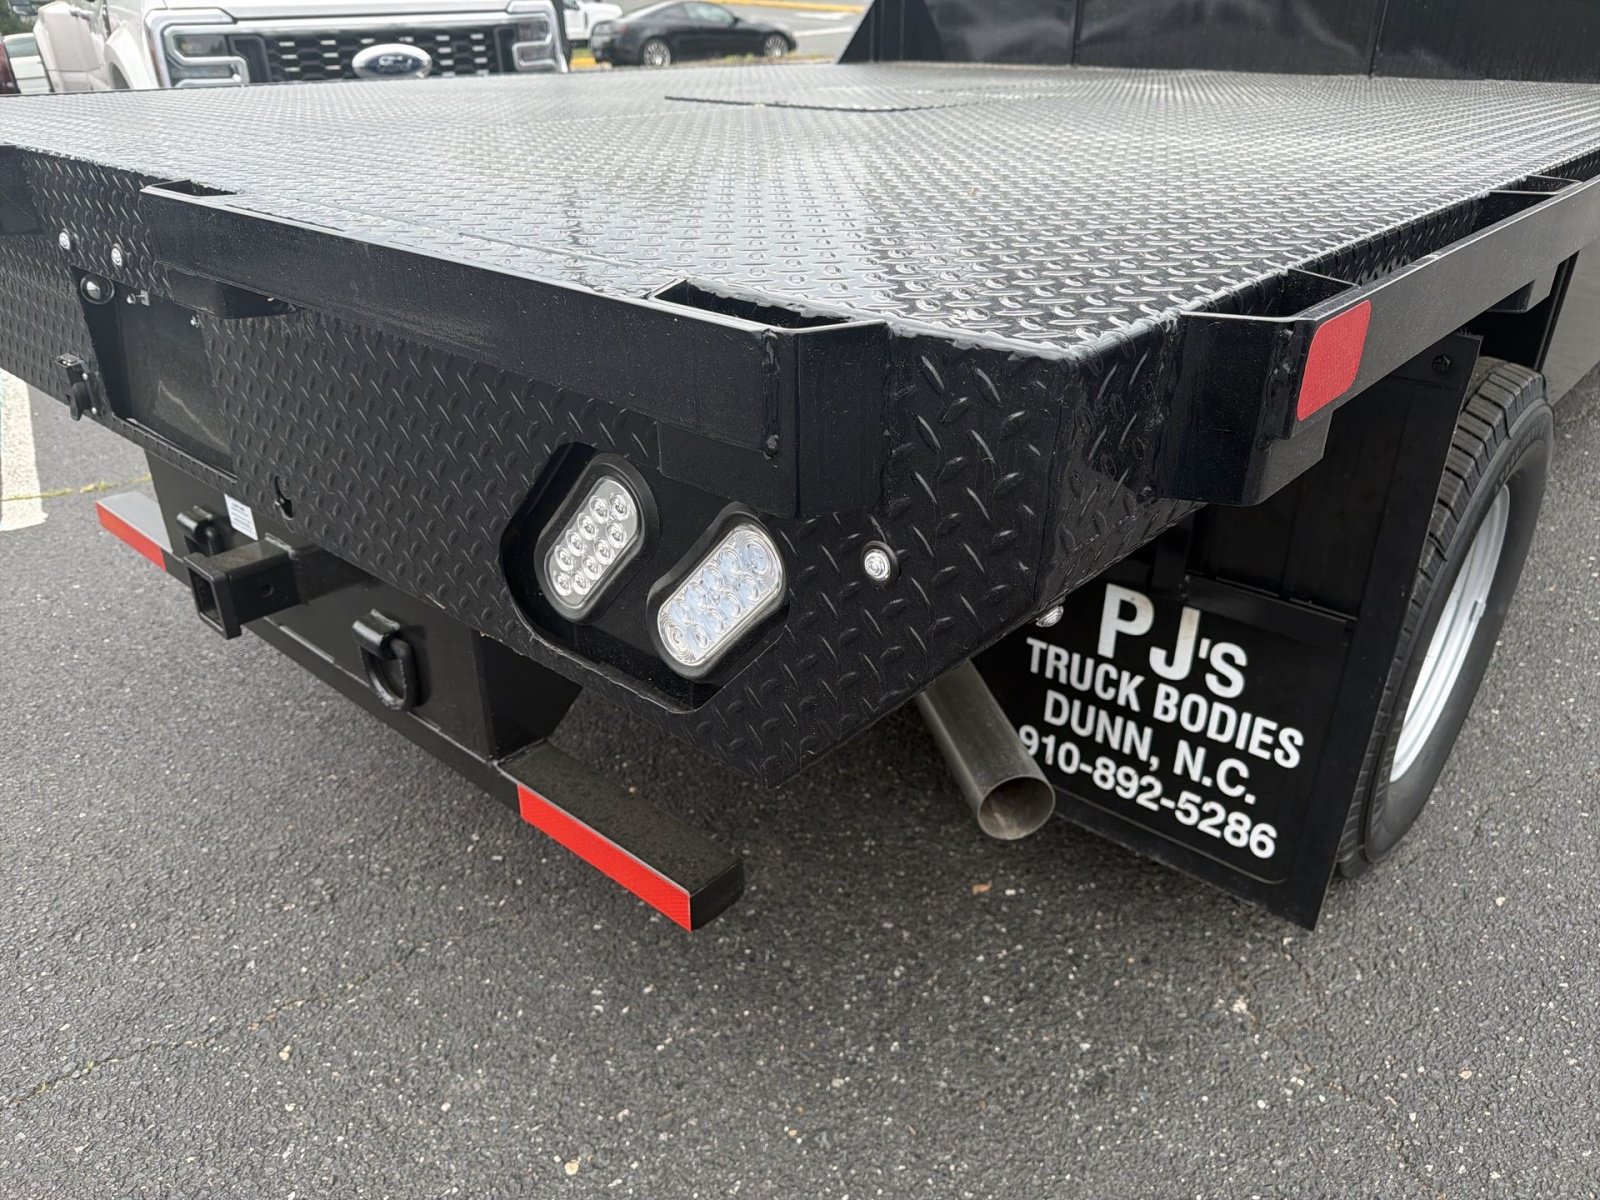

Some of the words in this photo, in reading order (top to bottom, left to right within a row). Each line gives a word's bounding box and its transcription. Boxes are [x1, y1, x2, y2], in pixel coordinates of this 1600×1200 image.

[1026, 637, 1145, 712] TRUCK
[1152, 682, 1304, 769] BODIES
[1044, 689, 1160, 772] DUNN,
[1173, 739, 1256, 805] N.C.
[1018, 725, 1278, 859] 910-892-5286
